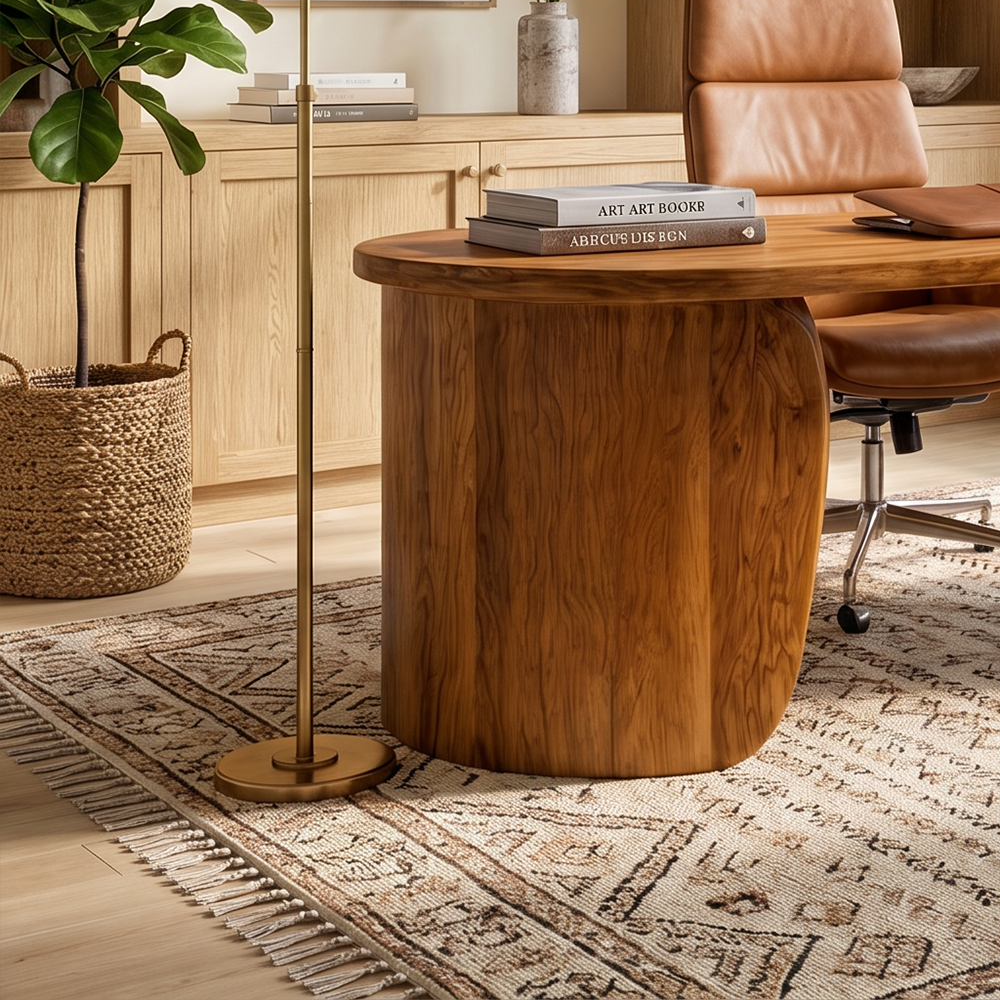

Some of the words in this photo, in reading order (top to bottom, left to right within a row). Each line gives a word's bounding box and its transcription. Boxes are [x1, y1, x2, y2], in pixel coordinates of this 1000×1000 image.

[598, 204, 625, 217] ART
[628, 203, 655, 215] ART
[658, 201, 705, 214] BOOKR
